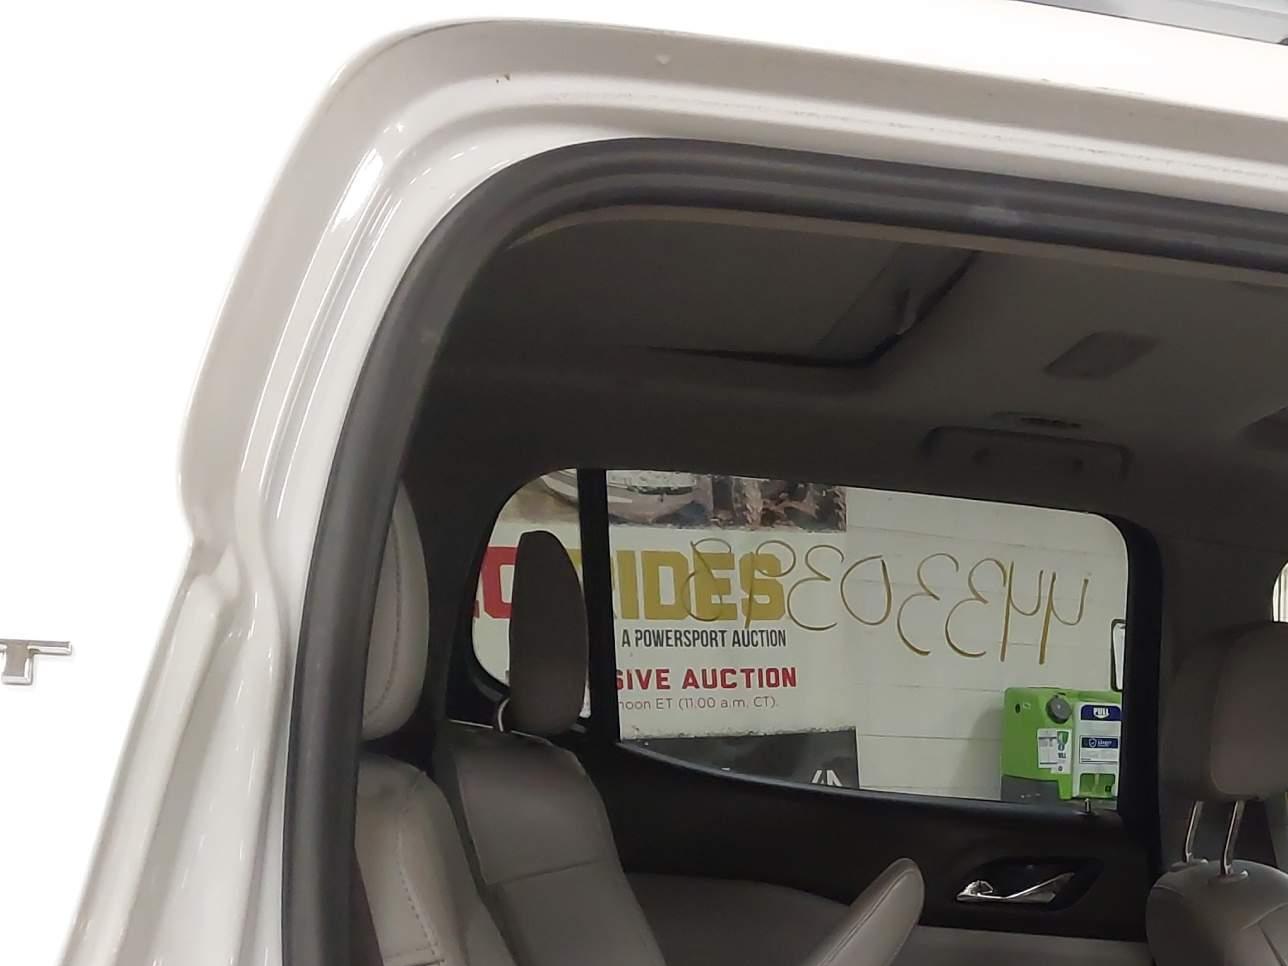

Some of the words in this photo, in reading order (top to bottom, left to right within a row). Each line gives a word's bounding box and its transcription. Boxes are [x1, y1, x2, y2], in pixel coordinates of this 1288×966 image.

[612, 549, 787, 621] IDES
[621, 629, 631, 648] A
[635, 629, 728, 648] POWERSPORT
[732, 629, 787, 648] AUCTION
[682, 667, 797, 690] AUCTION
[656, 698, 672, 710] ET
